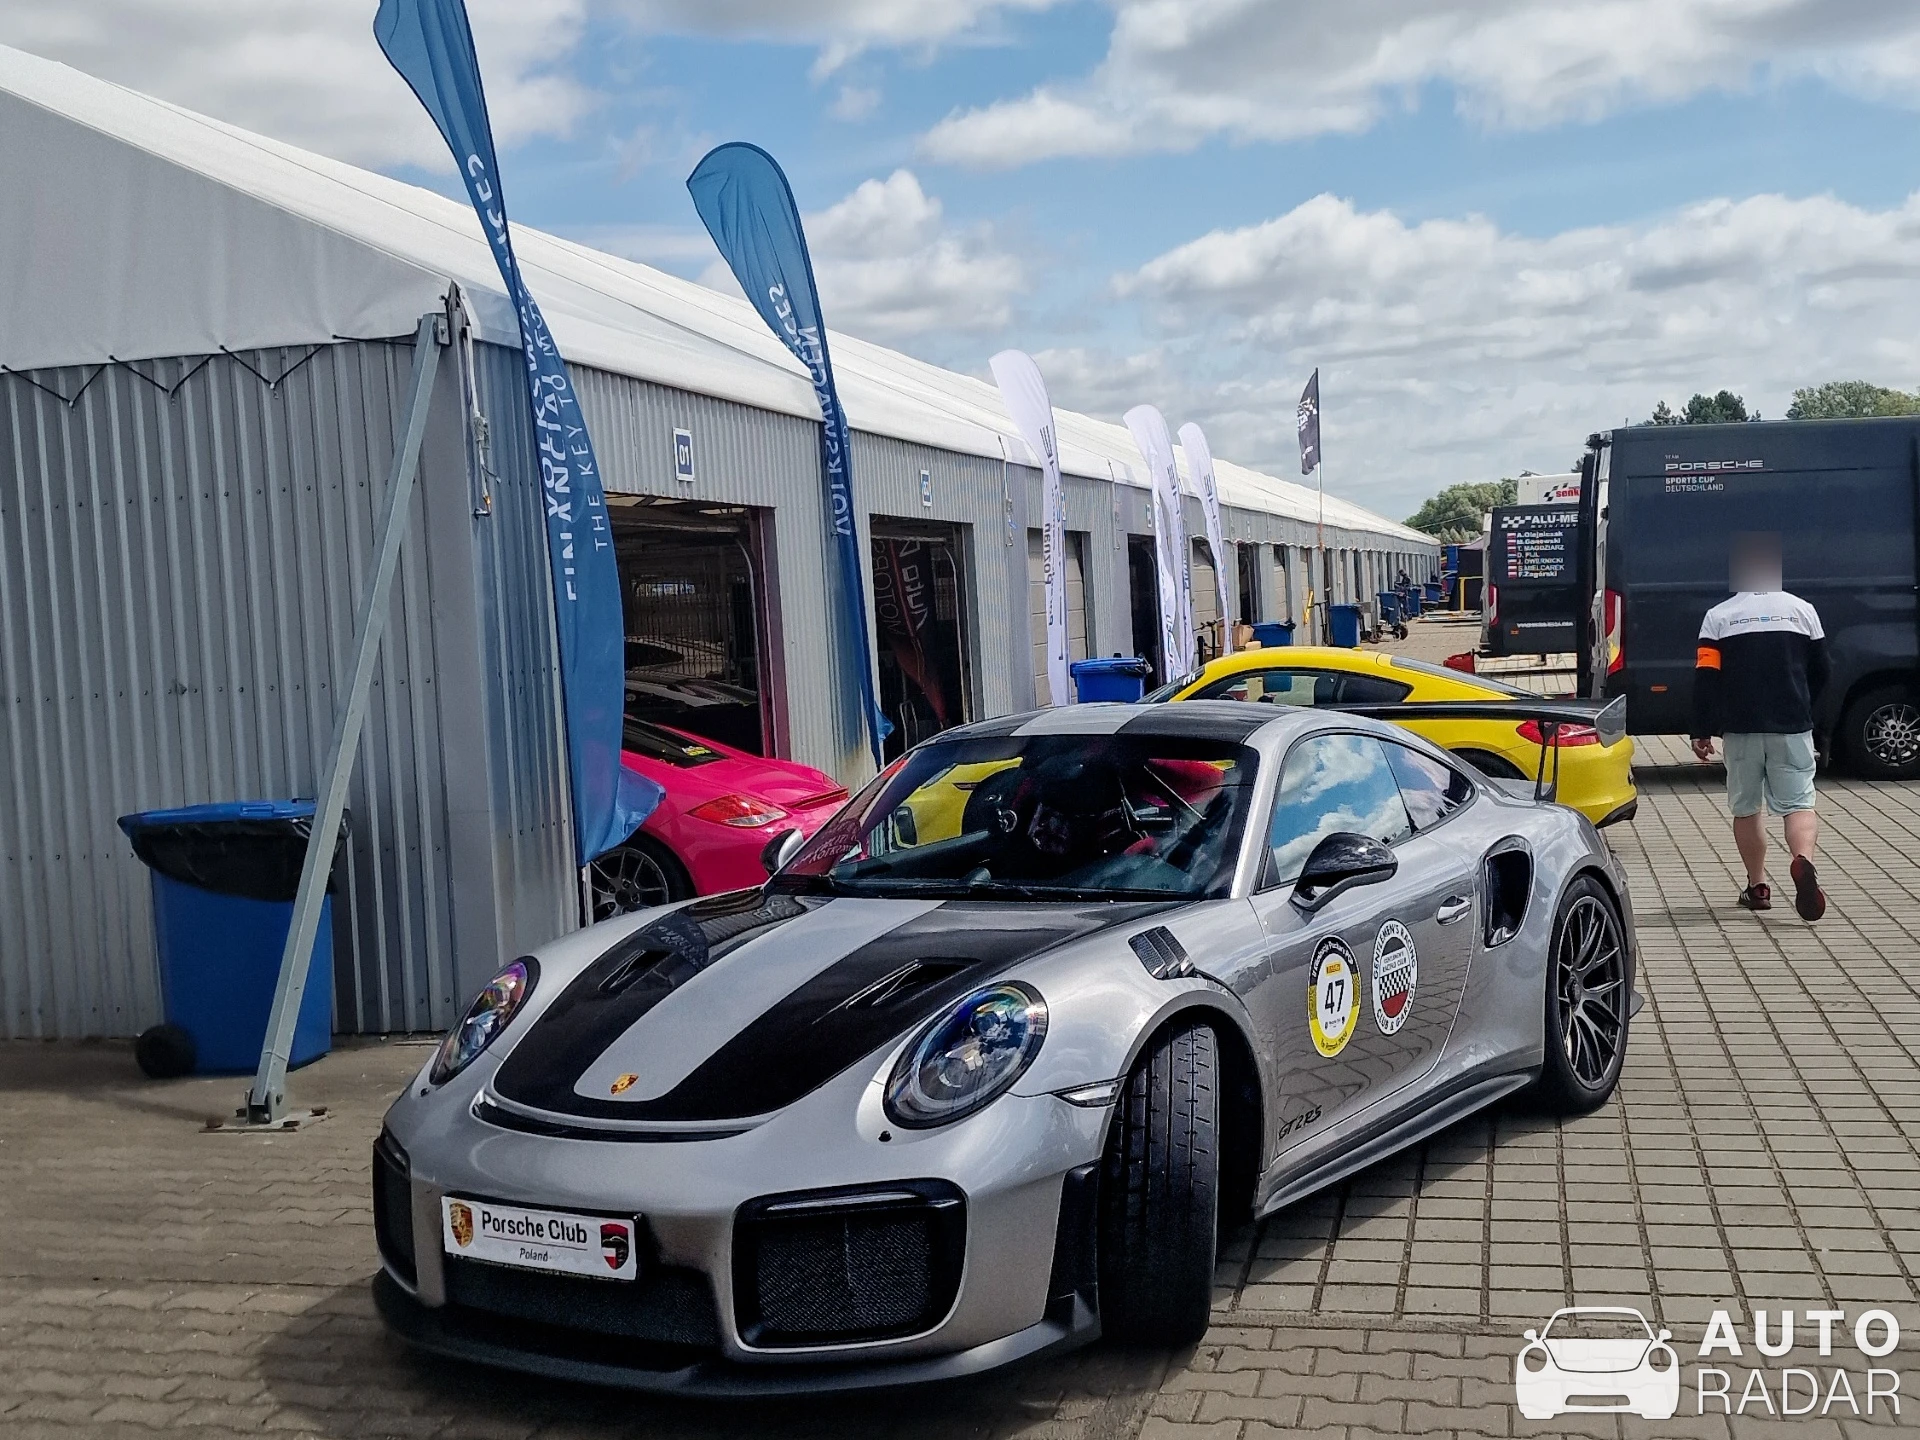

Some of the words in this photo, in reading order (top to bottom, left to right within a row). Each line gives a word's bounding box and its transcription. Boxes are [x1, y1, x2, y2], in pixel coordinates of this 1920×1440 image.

[551, 374, 574, 408] TO
[566, 424, 594, 476] KEY
[679, 444, 690, 466] 01
[1665, 460, 1764, 471] PORSCHE
[1665, 477, 1697, 485] SPORTS
[1698, 476, 1716, 484] CUP
[1665, 484, 1724, 493] DEUTSCHLAND
[587, 494, 608, 552] THE
[1729, 616, 1799, 626] PORSCHE
[1374, 923, 1400, 980] GENTLEMEN'S
[1400, 927, 1416, 968] RACING
[1325, 979, 1345, 1015] 47
[1376, 1008, 1389, 1029] CLUB
[1395, 984, 1416, 1027] GARAGE
[481, 1210, 544, 1238] Porsche
[548, 1219, 588, 1244] Club
[519, 1248, 549, 1262] Poland
